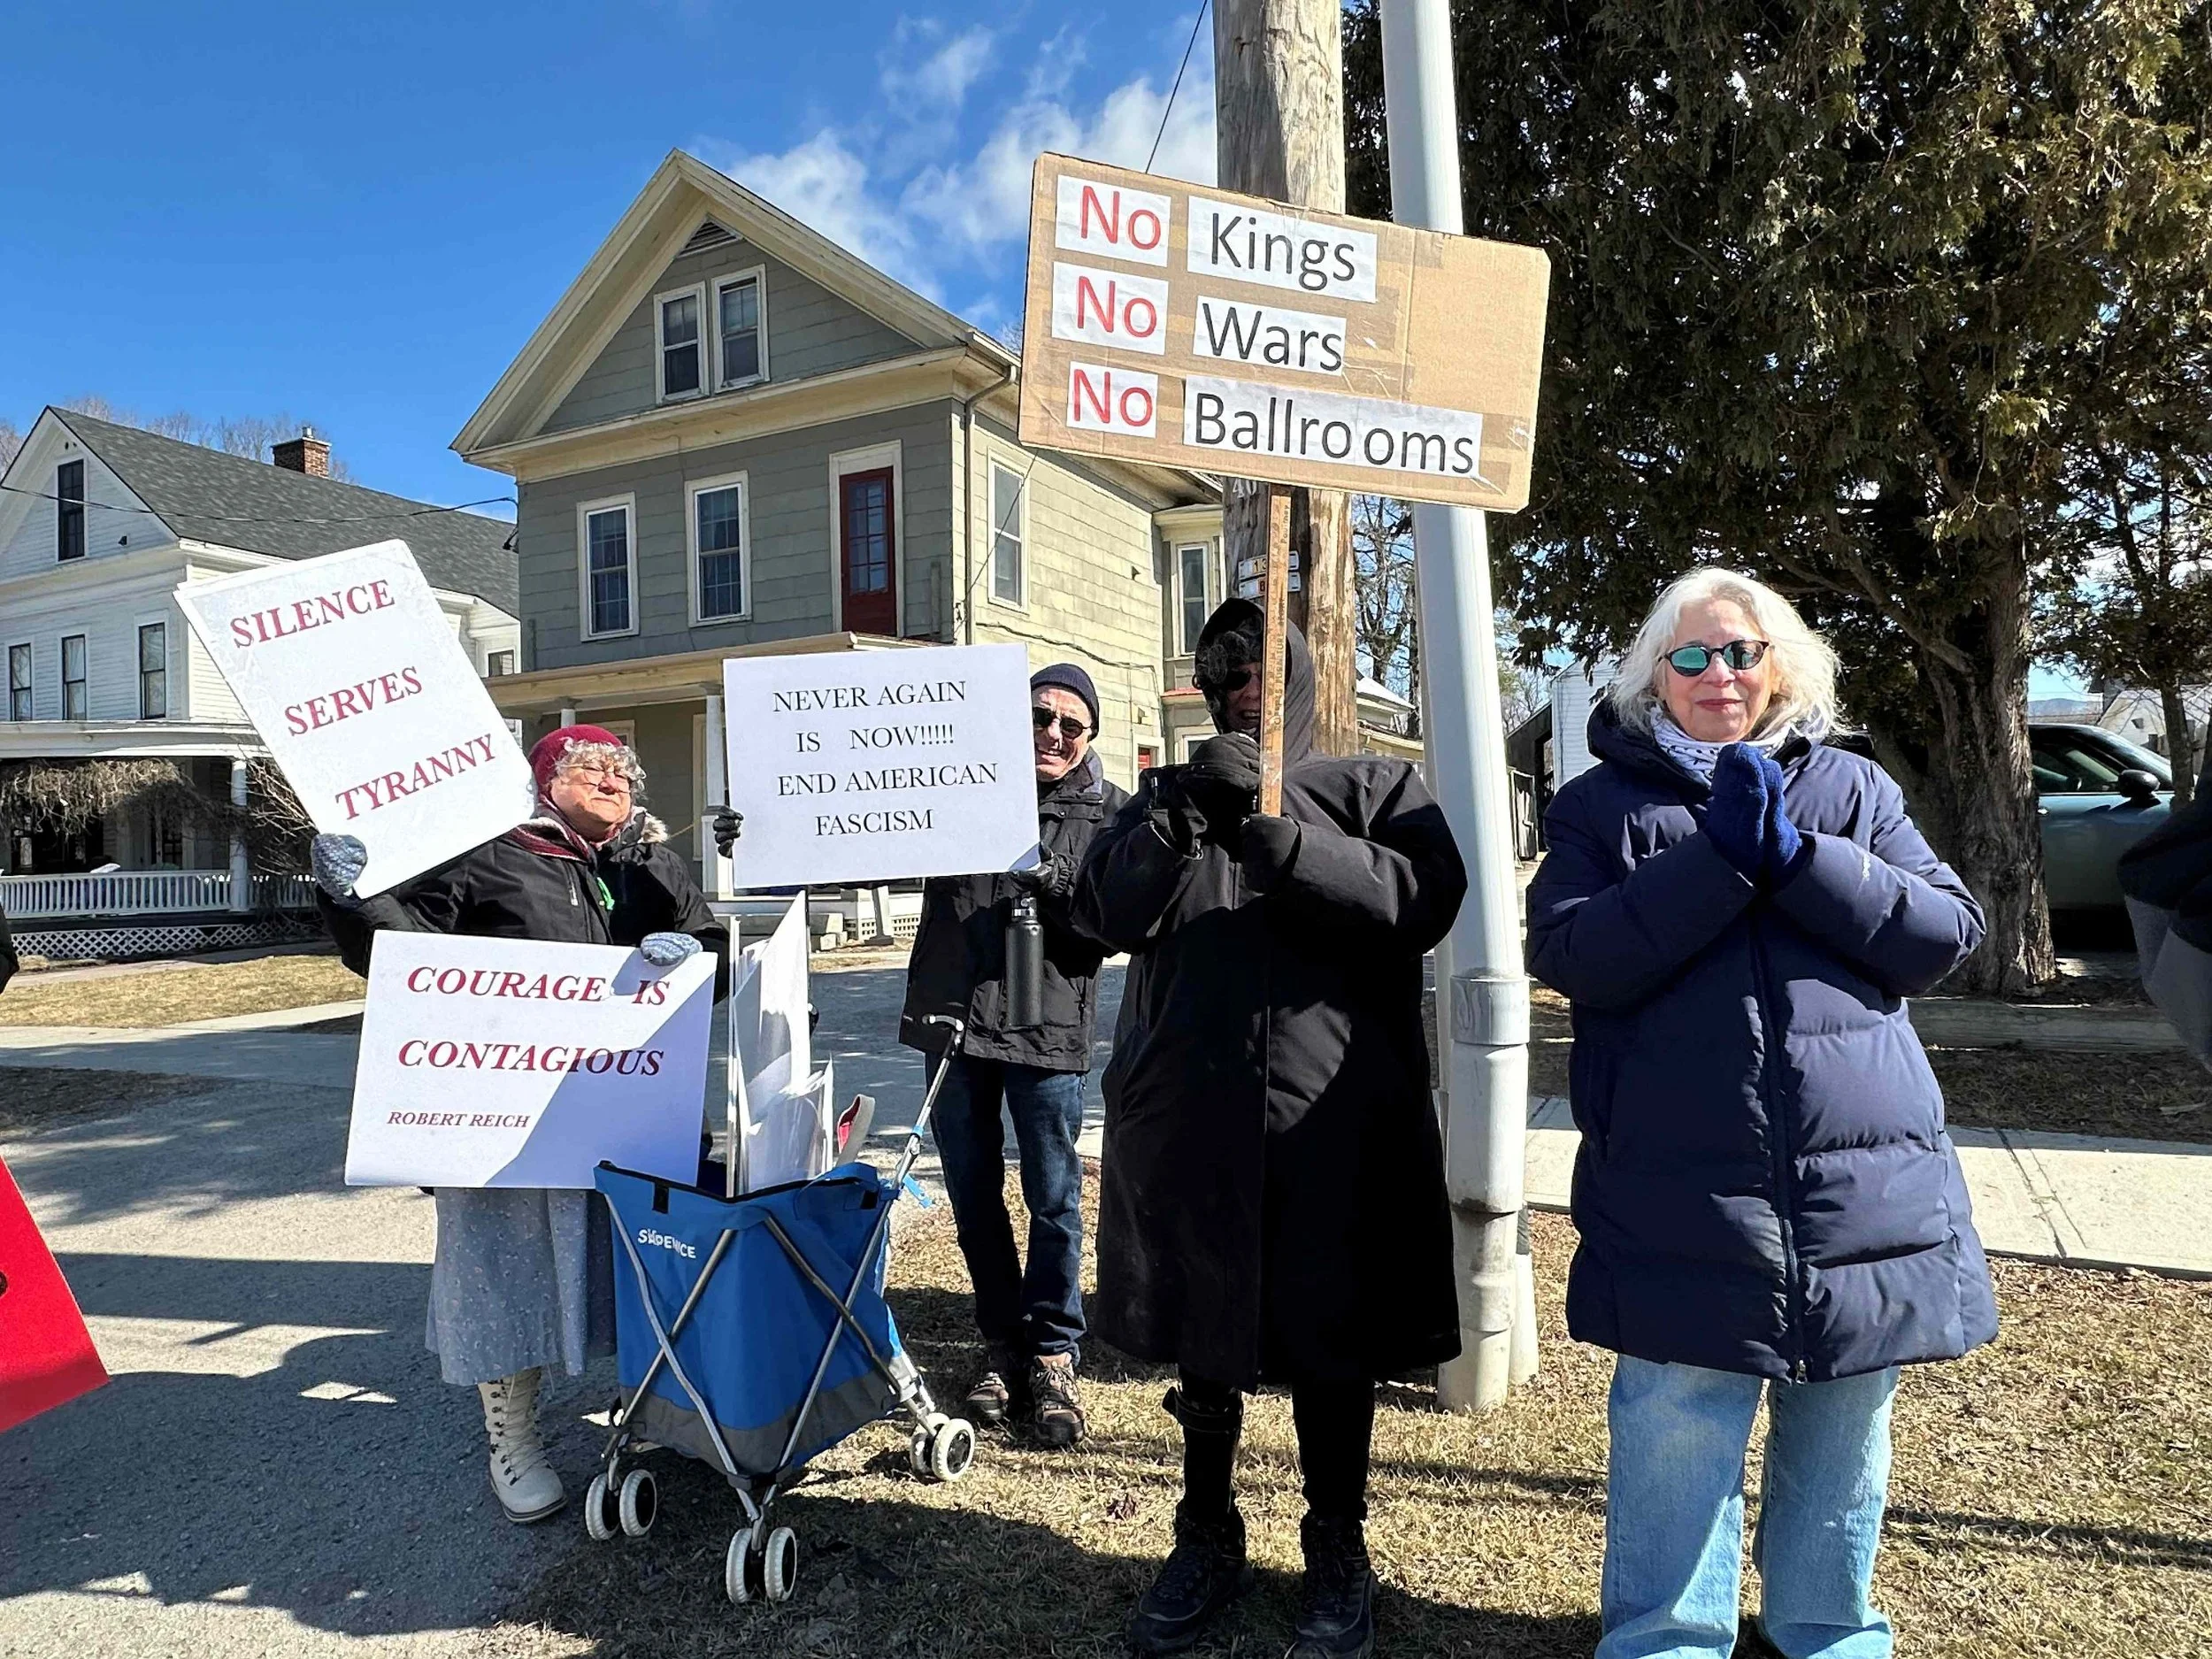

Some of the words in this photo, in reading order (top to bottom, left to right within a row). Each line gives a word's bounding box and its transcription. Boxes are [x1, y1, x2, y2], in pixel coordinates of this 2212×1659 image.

[1079, 184, 1162, 250] No
[1210, 212, 1356, 291] Kings
[1076, 275, 1158, 338] No
[1202, 303, 1342, 372] Wars
[1072, 368, 1154, 427] No
[1194, 392, 1474, 474] Ballrooms
[228, 579, 396, 649] SILENCE
[284, 665, 423, 737] SERVES
[773, 687, 870, 712] NEVER
[877, 680, 965, 706] AGAIN
[796, 732, 820, 753] IS
[849, 724, 954, 749] NOW!!!!!
[334, 733, 496, 820] TYRANNY
[779, 773, 836, 796] END
[845, 763, 997, 792] AMERICAN
[816, 809, 933, 836] FASCISM
[407, 966, 606, 1002] COURAGE
[631, 979, 671, 1006] IS
[398, 1039, 664, 1077] CONTAGIOUS
[387, 1110, 468, 1127] ROBERT
[468, 1113, 532, 1129] REICH
